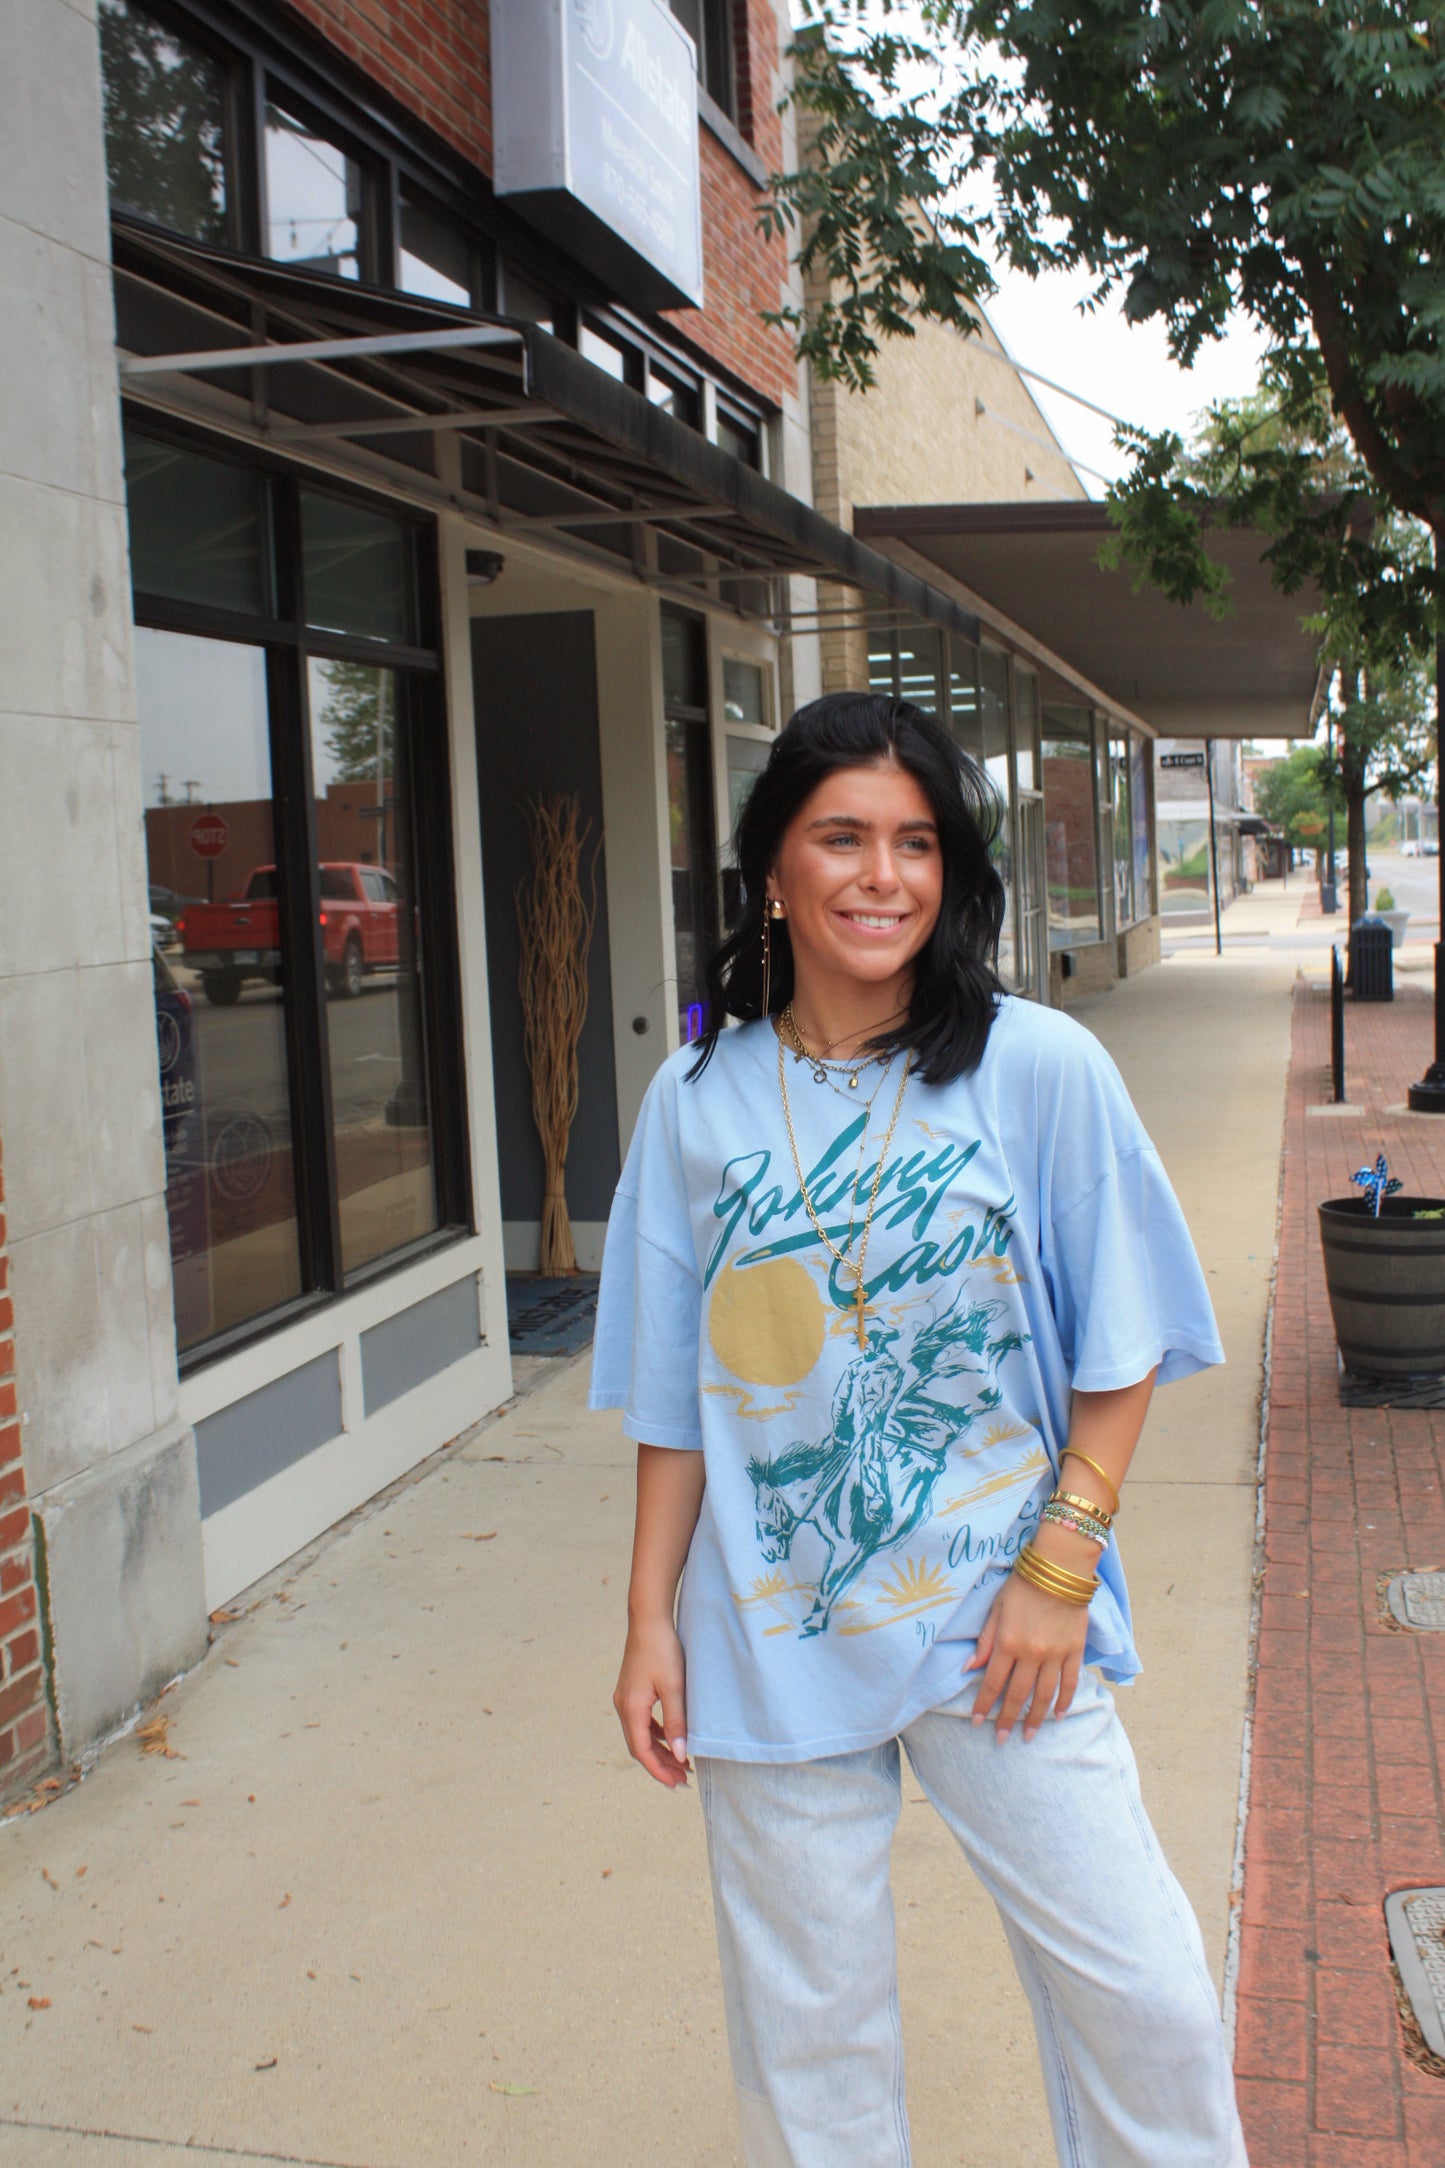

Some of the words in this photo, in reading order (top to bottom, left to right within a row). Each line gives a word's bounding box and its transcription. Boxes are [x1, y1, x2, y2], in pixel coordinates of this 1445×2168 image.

[620, 21, 689, 144] Allstate
[703, 1110, 982, 1292] Johnny
[736, 1185, 1017, 1311] Cash
